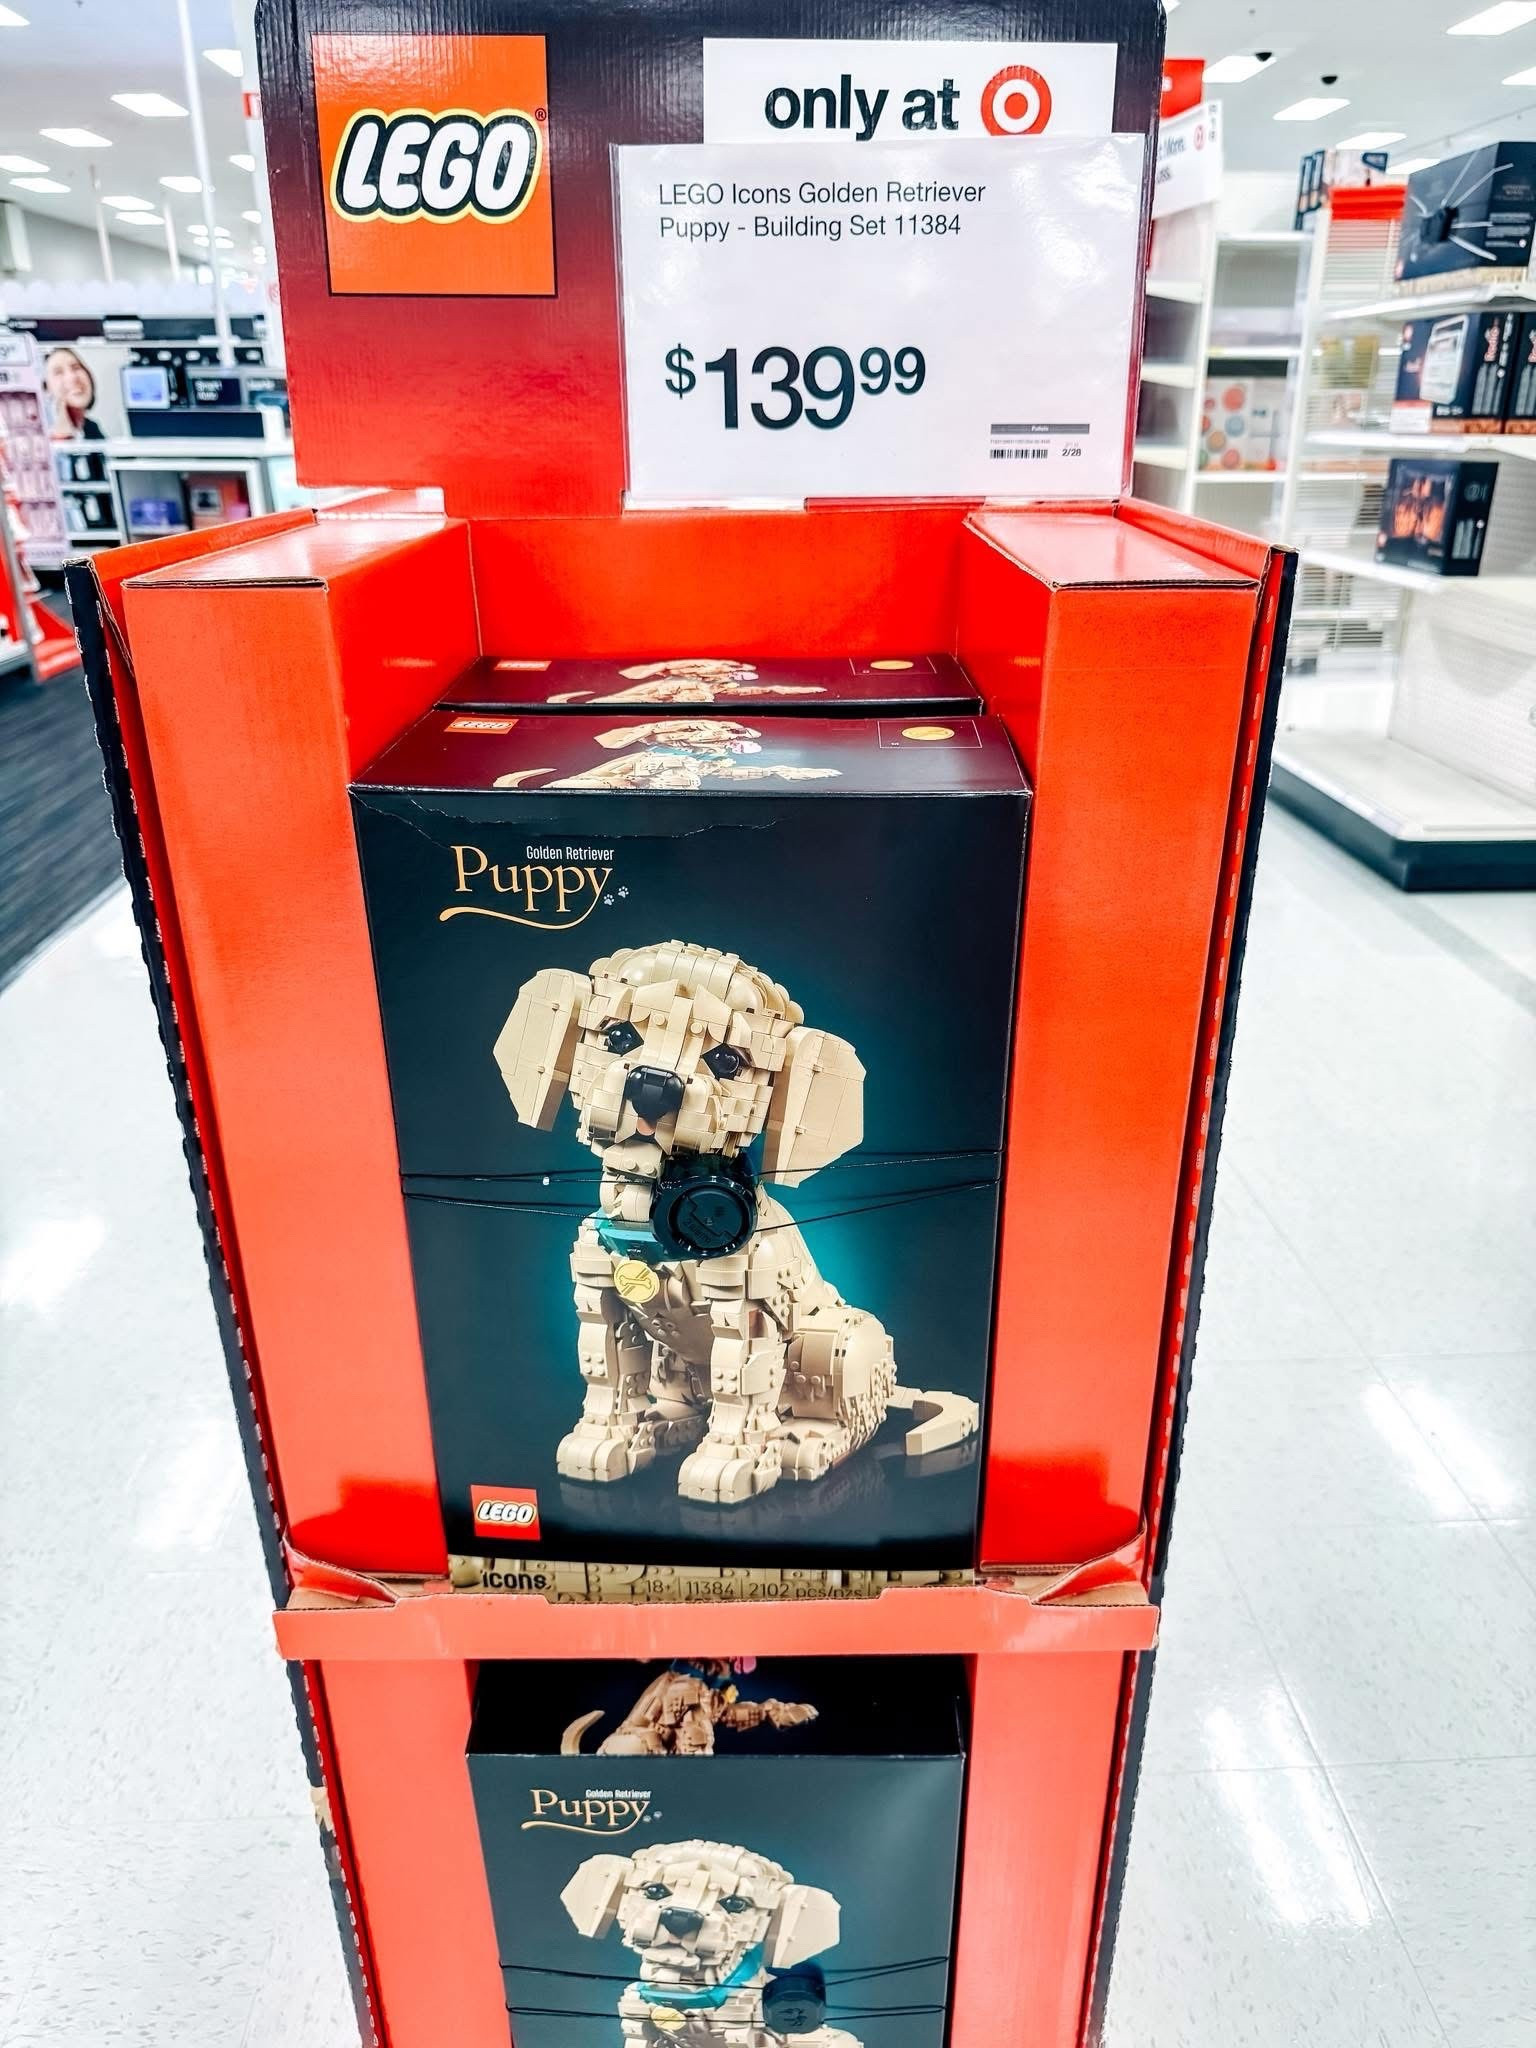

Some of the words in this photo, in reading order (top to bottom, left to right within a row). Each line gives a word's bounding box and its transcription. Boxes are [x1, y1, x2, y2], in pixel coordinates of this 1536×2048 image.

[765, 74, 890, 141] only
[902, 78, 960, 130] at
[336, 114, 538, 217] LEGO
[659, 183, 724, 205] LEGO
[732, 183, 791, 204] Icons
[798, 181, 878, 203] Golden
[887, 181, 986, 202] Retriever
[660, 217, 730, 242] Puppy
[754, 216, 842, 241] Building
[850, 214, 886, 236] Set
[895, 214, 961, 236] 11384
[526, 845, 563, 860] Golden
[566, 847, 615, 861] Retriever
[439, 845, 613, 929] Puppy
[478, 1501, 534, 1523] LEGO
[481, 1570, 548, 1590] icons
[646, 1579, 671, 1592] 18+
[686, 1580, 735, 1596] 11384
[750, 1582, 789, 1597] 2102
[585, 1789, 613, 1798] Golden
[615, 1789, 652, 1799] Retriever
[521, 1789, 651, 1835] Puppy
